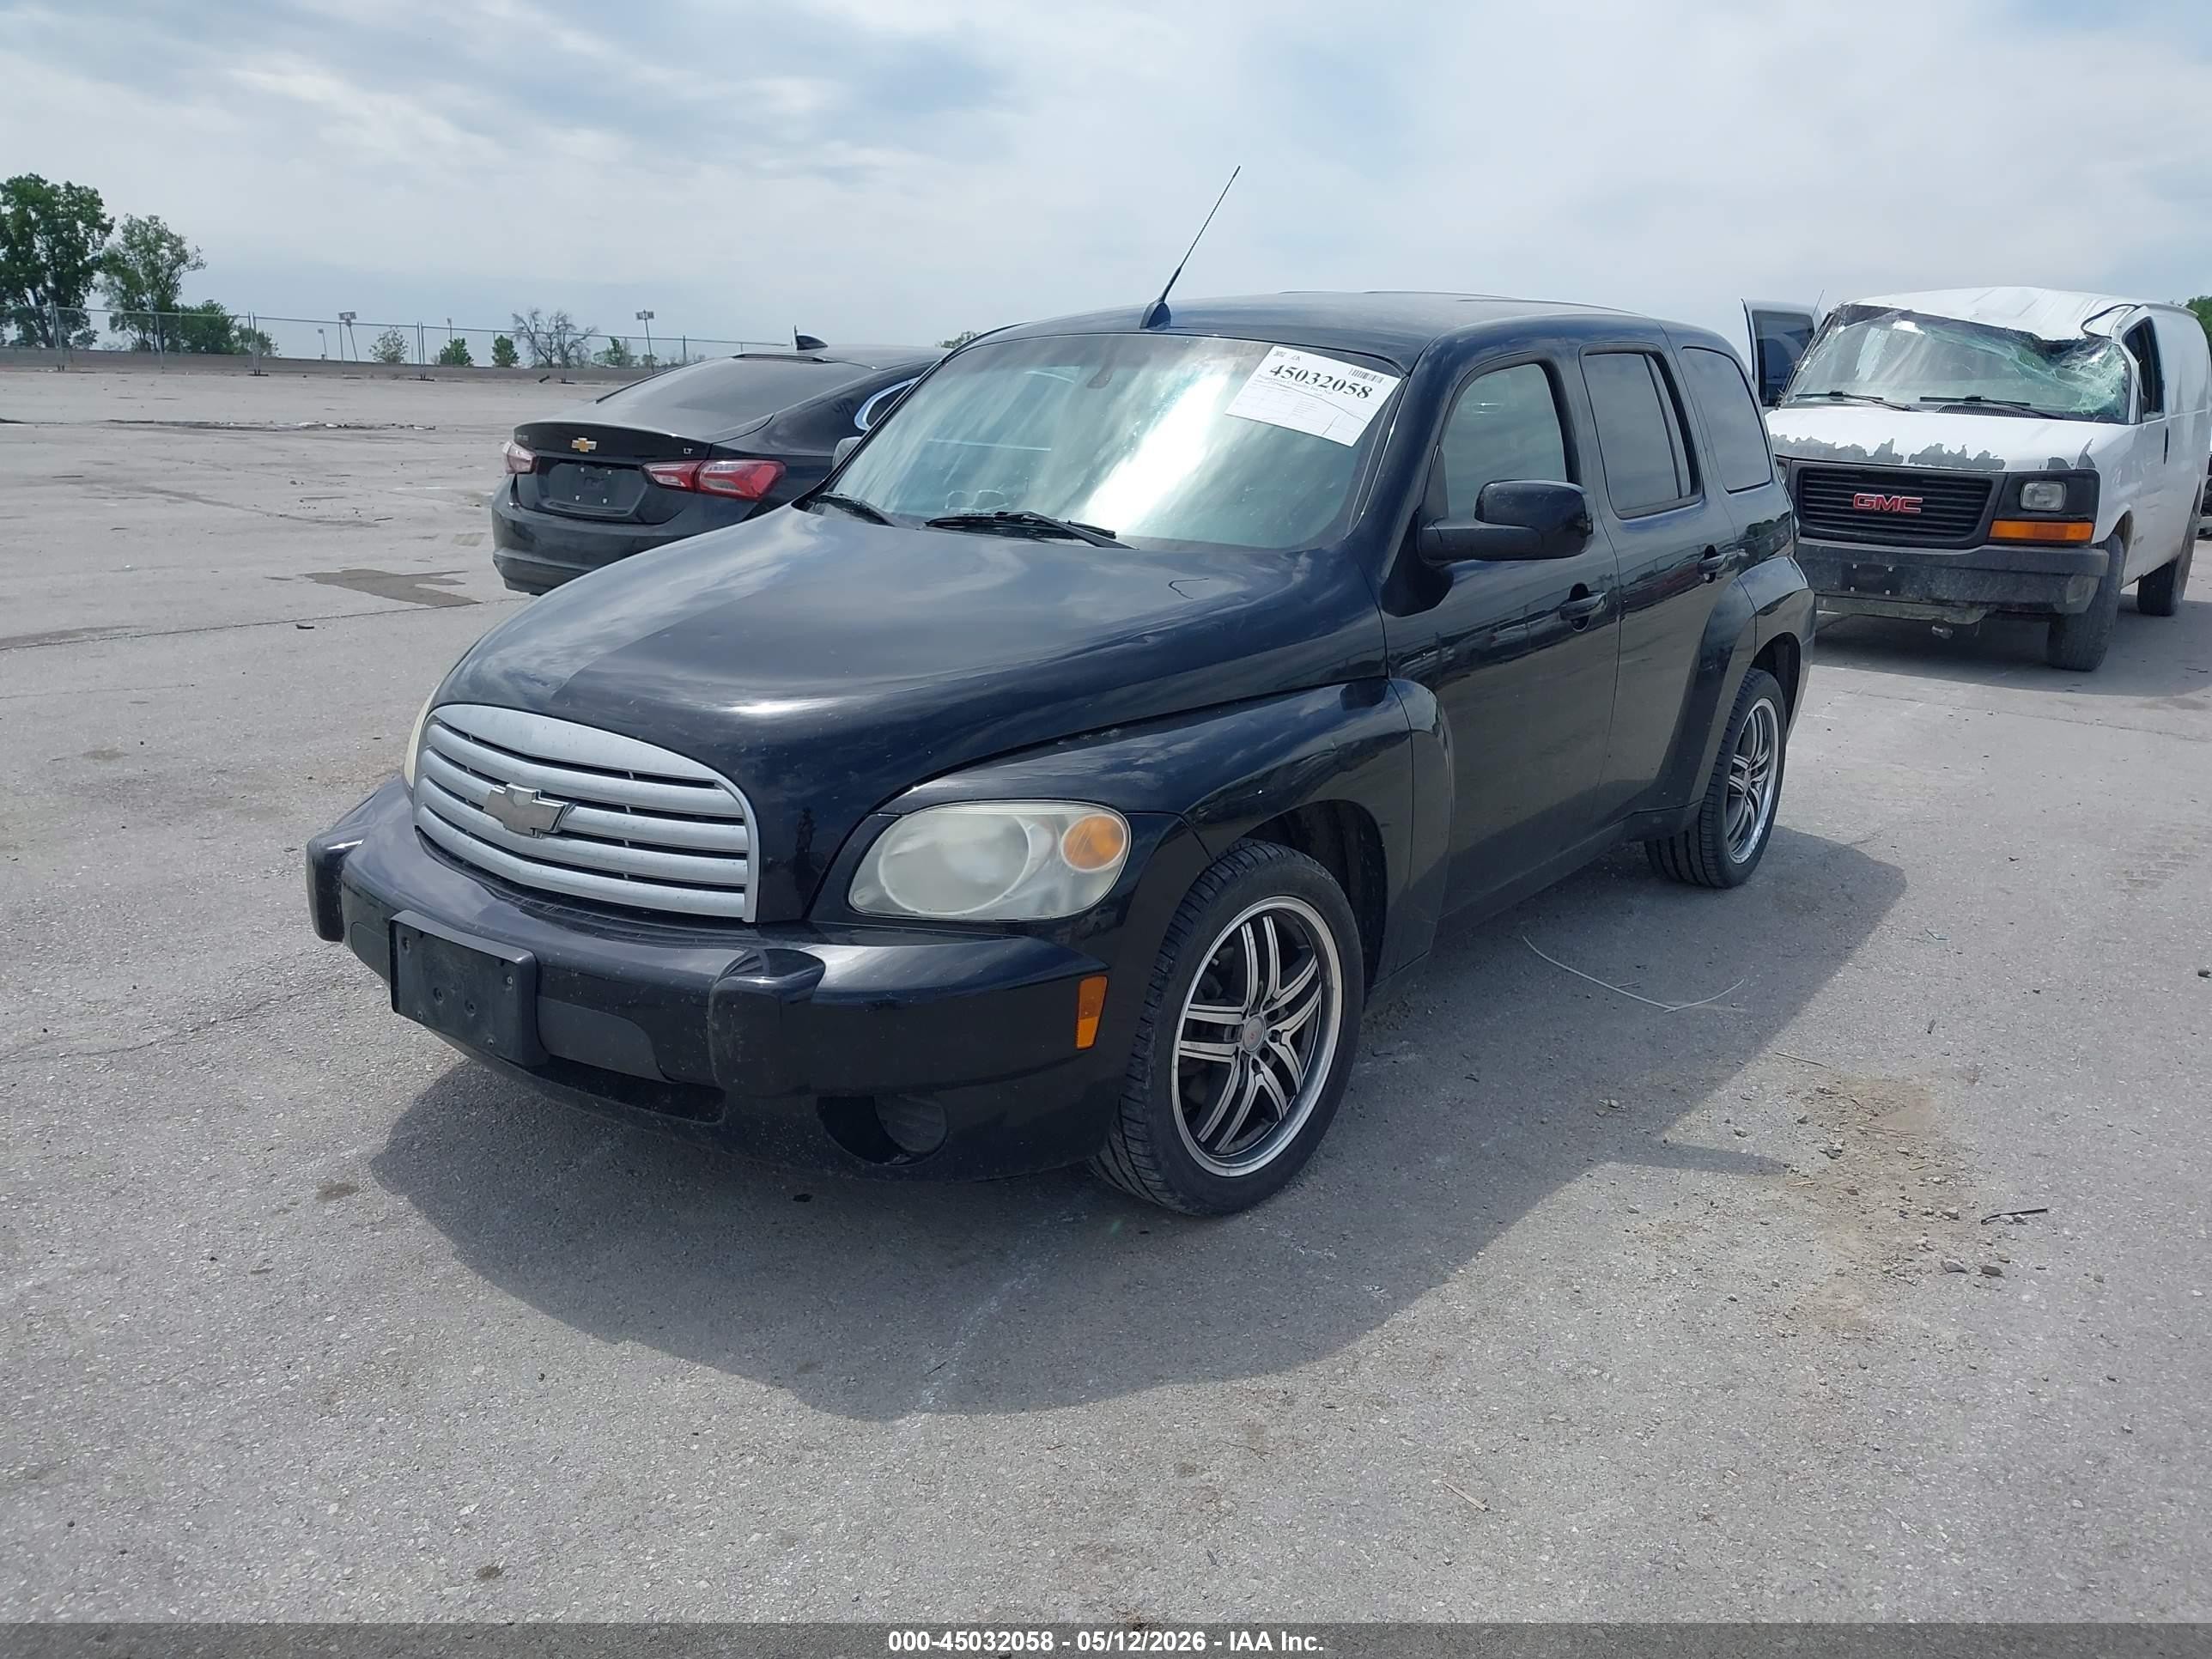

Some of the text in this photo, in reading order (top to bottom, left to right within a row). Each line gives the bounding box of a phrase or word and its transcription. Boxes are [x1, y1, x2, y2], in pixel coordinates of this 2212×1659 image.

[1269, 364, 1373, 399] 45032058
[683, 447, 694, 455] LT
[1854, 493, 1923, 514] GMC
